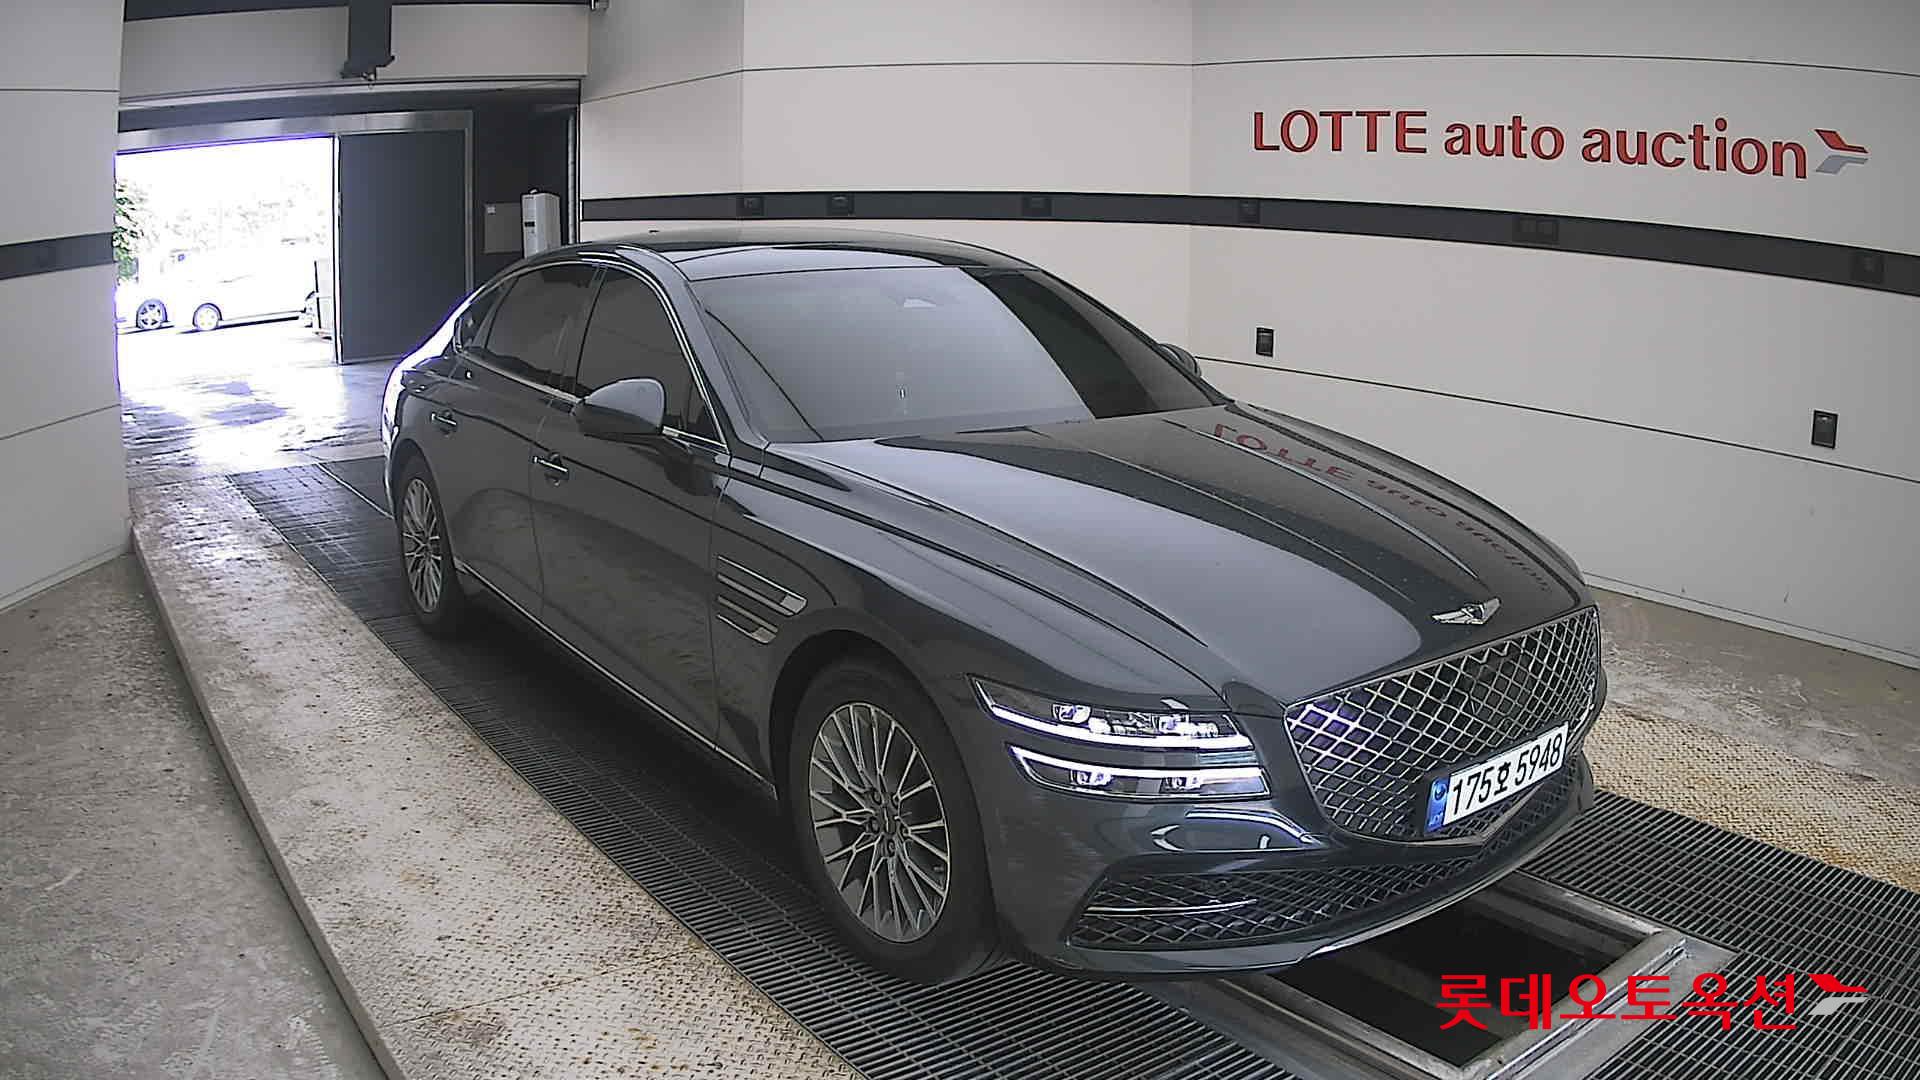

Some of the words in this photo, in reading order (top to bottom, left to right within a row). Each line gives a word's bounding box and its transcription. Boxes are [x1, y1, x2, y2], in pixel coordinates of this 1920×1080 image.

[1253, 110, 1428, 153] LOTTE
[1443, 115, 1565, 161] auto
[1581, 117, 1808, 180] auction
[1453, 761, 1512, 816] 175호
[1515, 733, 1563, 786] 5948
